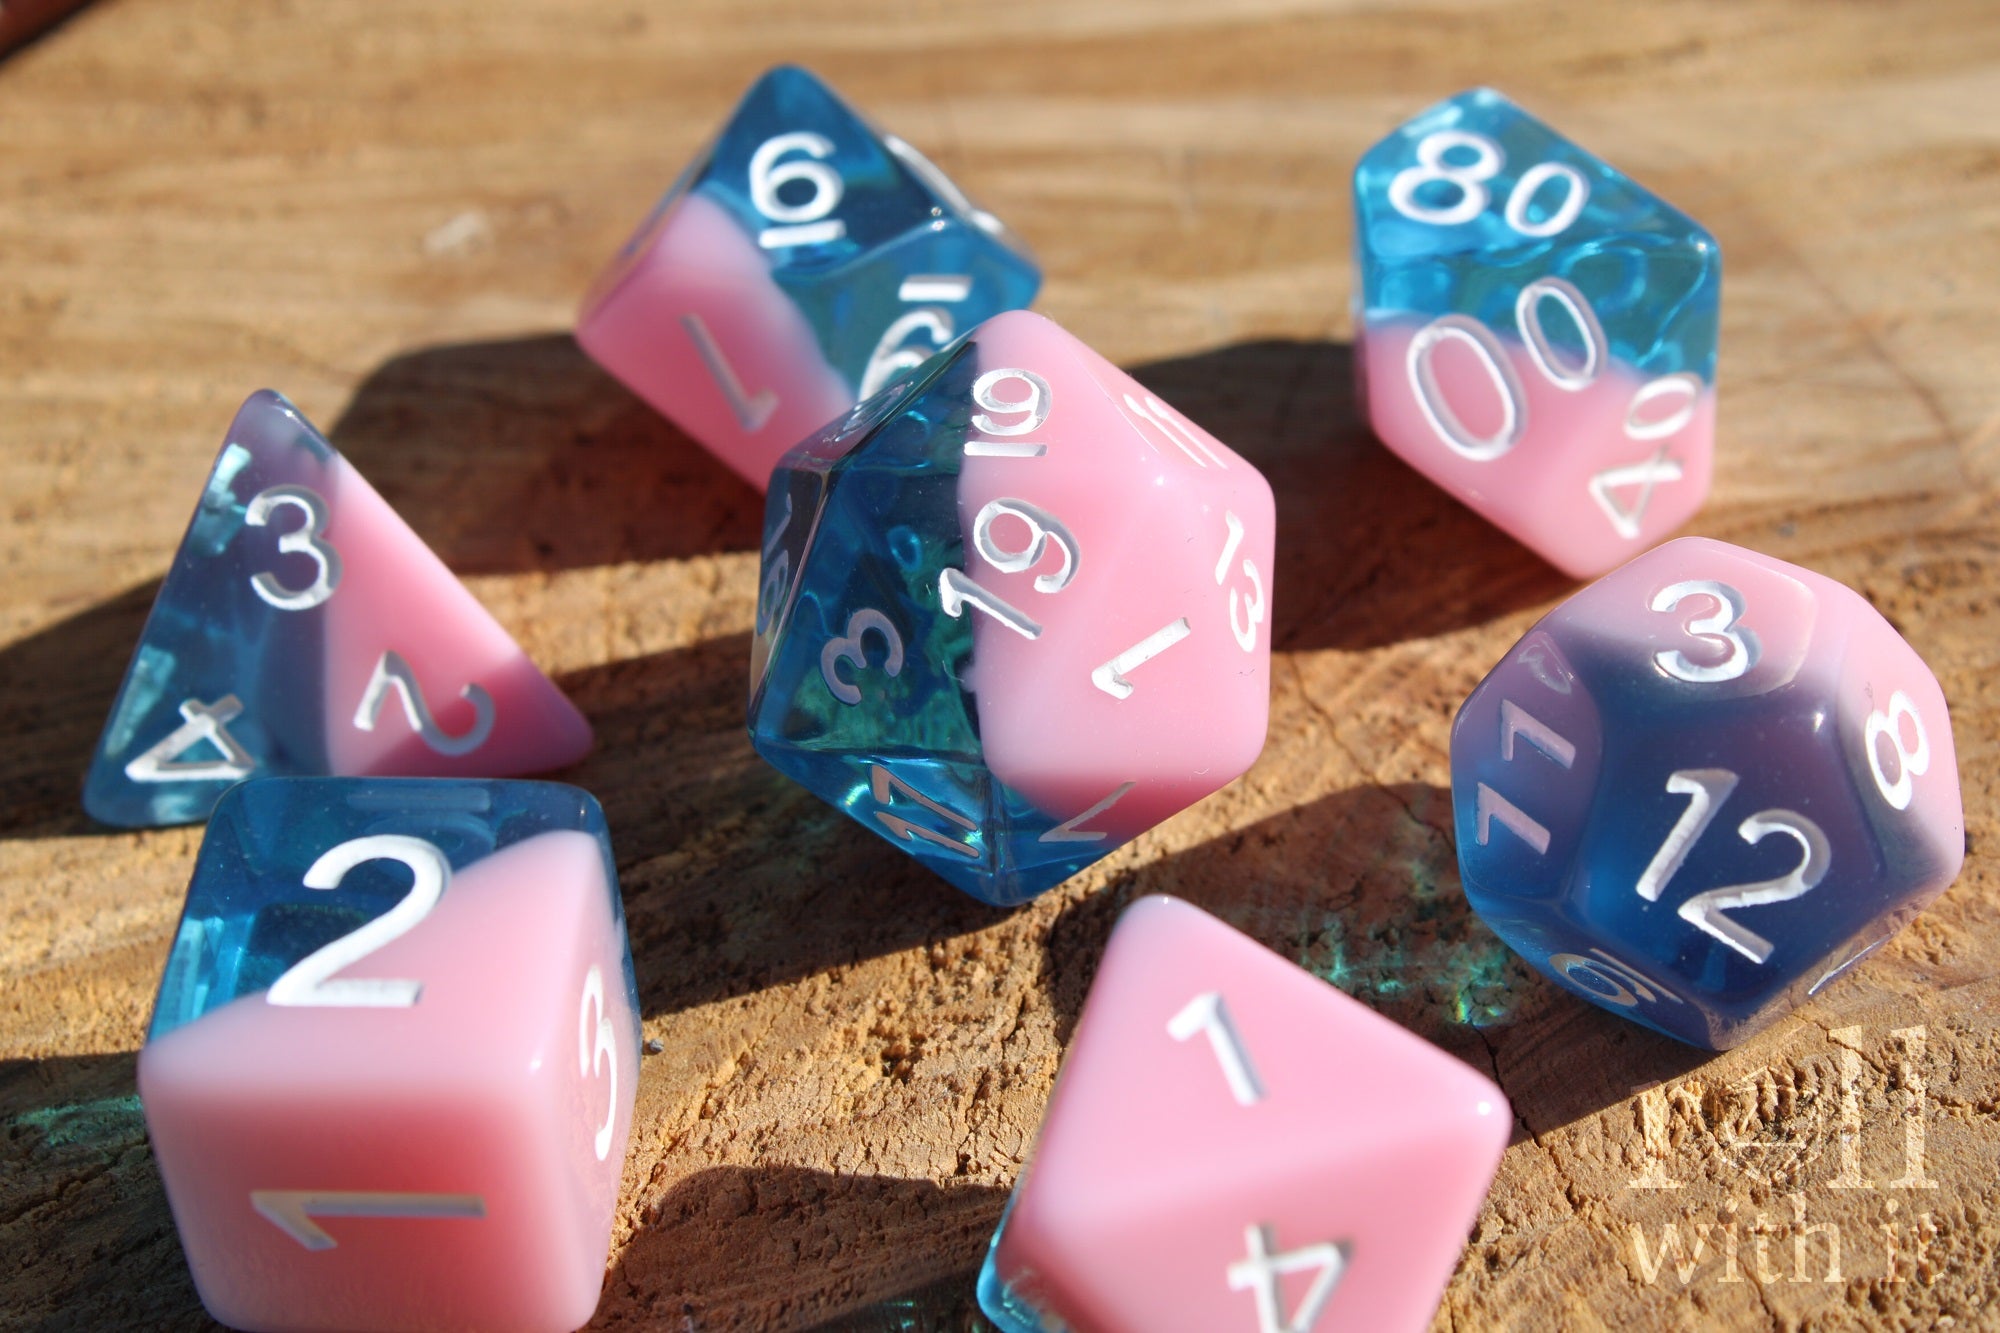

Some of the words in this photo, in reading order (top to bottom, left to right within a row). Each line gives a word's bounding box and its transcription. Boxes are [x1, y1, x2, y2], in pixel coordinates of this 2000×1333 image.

[1388, 130, 1590, 238] 80
[1406, 277, 1608, 461] 00
[245, 483, 343, 611] 3
[939, 497, 1080, 640] 19
[1215, 510, 1264, 653] 13
[821, 609, 904, 705] 3
[1091, 616, 1191, 700] 1
[1646, 580, 1761, 683] 3
[125, 694, 253, 781] 4
[353, 650, 495, 756] 2
[1864, 690, 1929, 810] 8
[1475, 698, 1576, 856] 11
[266, 834, 452, 1008] 2
[1636, 768, 1831, 964] 12
[579, 964, 617, 1161] 3
[1166, 992, 1267, 1106] 1
[249, 1190, 486, 1250] 1
